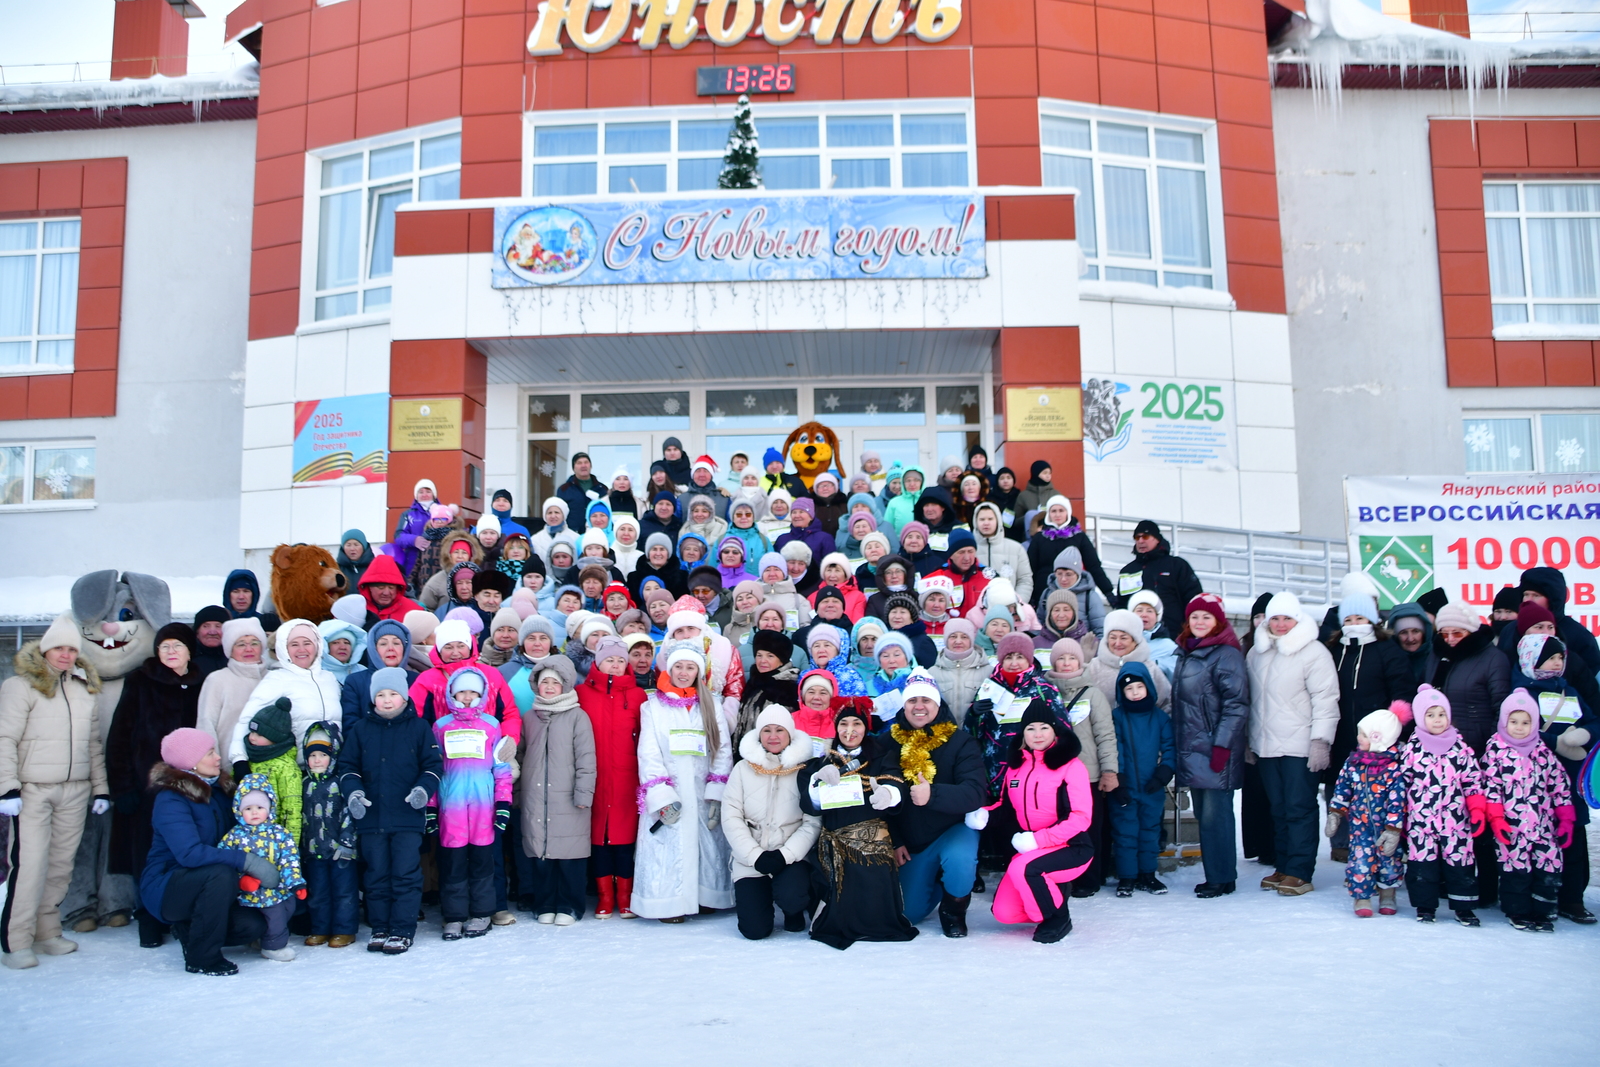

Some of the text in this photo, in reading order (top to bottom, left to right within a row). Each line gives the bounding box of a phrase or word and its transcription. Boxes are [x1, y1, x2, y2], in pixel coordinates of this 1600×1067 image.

[726, 64, 792, 92] 13:26
[603, 203, 976, 273] С Новым годом!
[1140, 382, 1224, 422] 2025
[314, 412, 343, 429] 2025
[313, 430, 363, 441] Год защитника
[313, 442, 347, 451] Отечества
[1441, 481, 1546, 499] Янаульский
[1358, 501, 1600, 522] ВСЕРОССИЙСКАЯ
